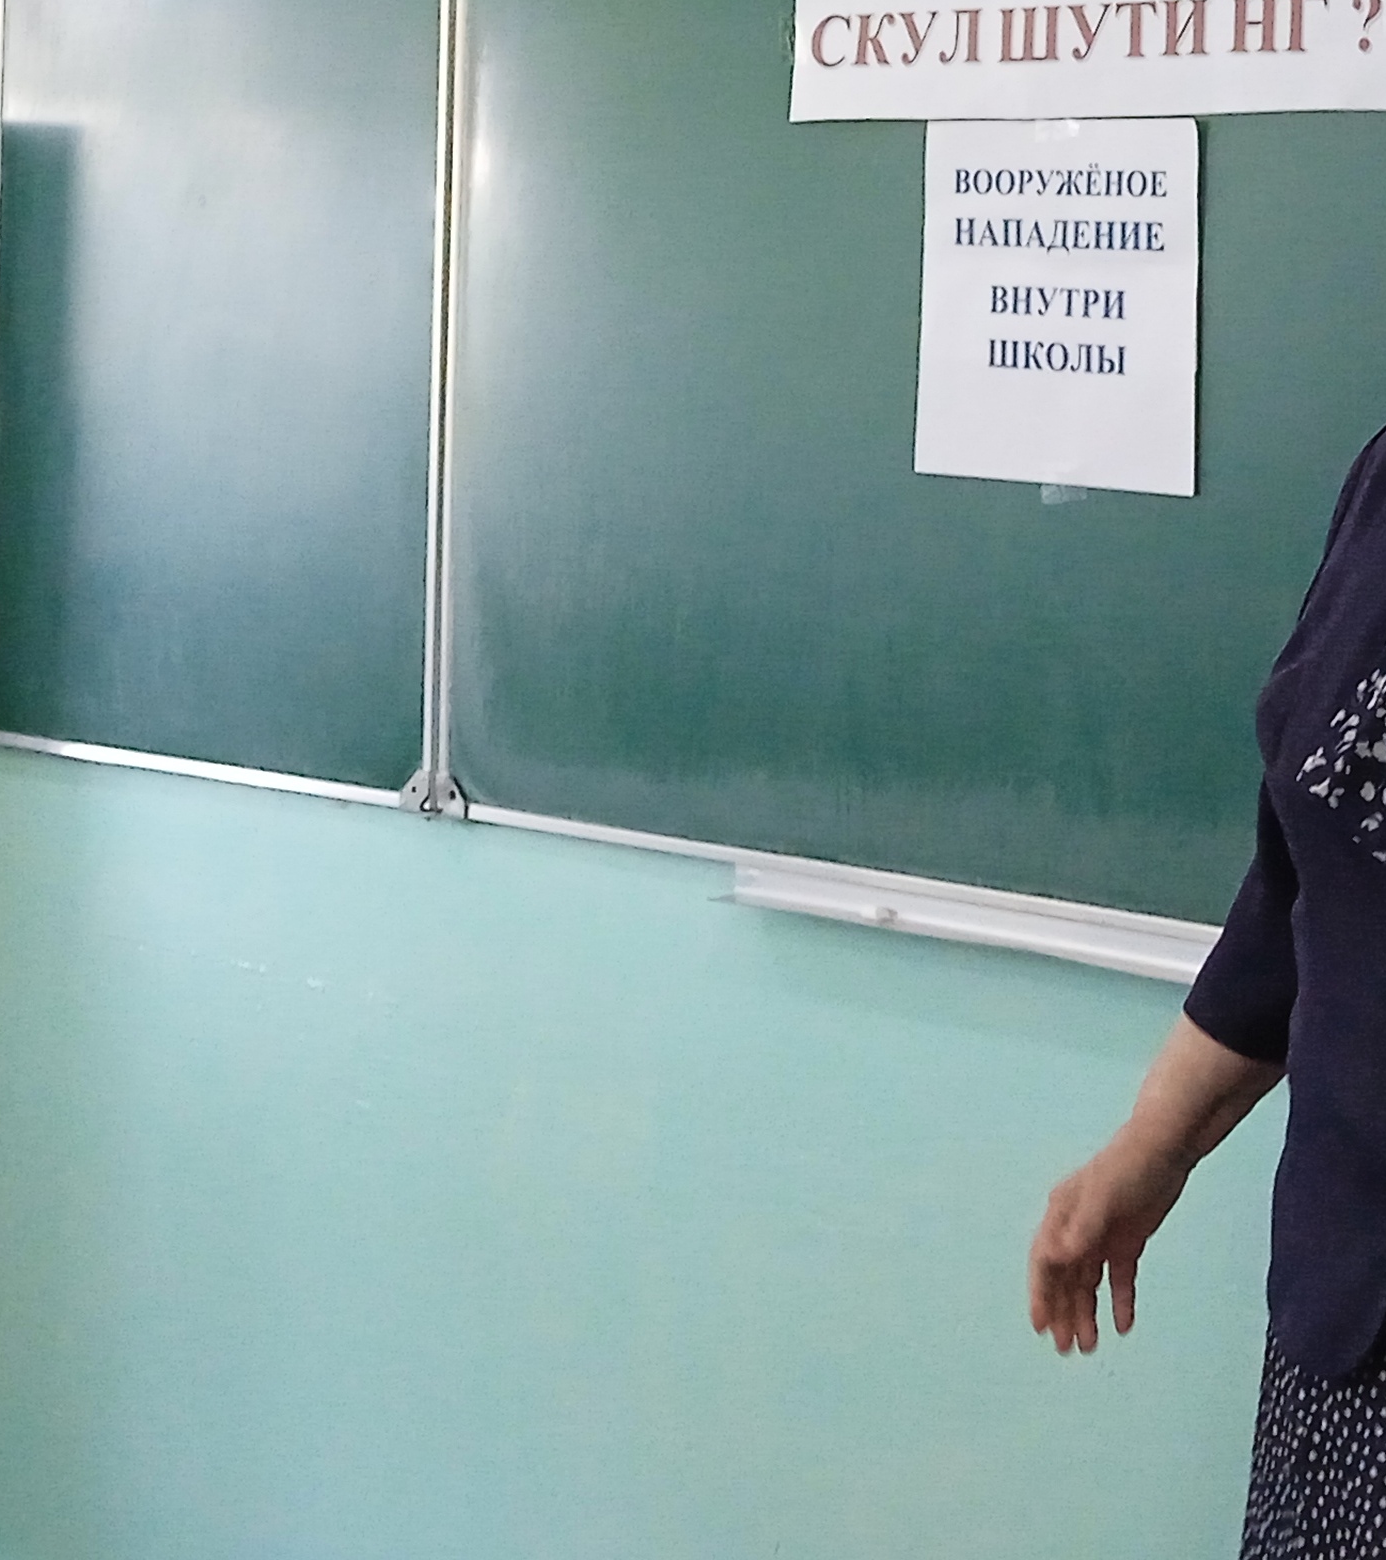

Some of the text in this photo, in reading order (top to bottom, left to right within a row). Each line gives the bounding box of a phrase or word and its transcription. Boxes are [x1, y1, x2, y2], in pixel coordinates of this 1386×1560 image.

[954, 163, 1168, 199] ВООРУЖЁНОЕ
[954, 217, 1166, 253] НАПАДЕНИЕ
[989, 285, 1126, 321] ВНУТРИ
[987, 339, 1126, 376] ШКОЛЫ
